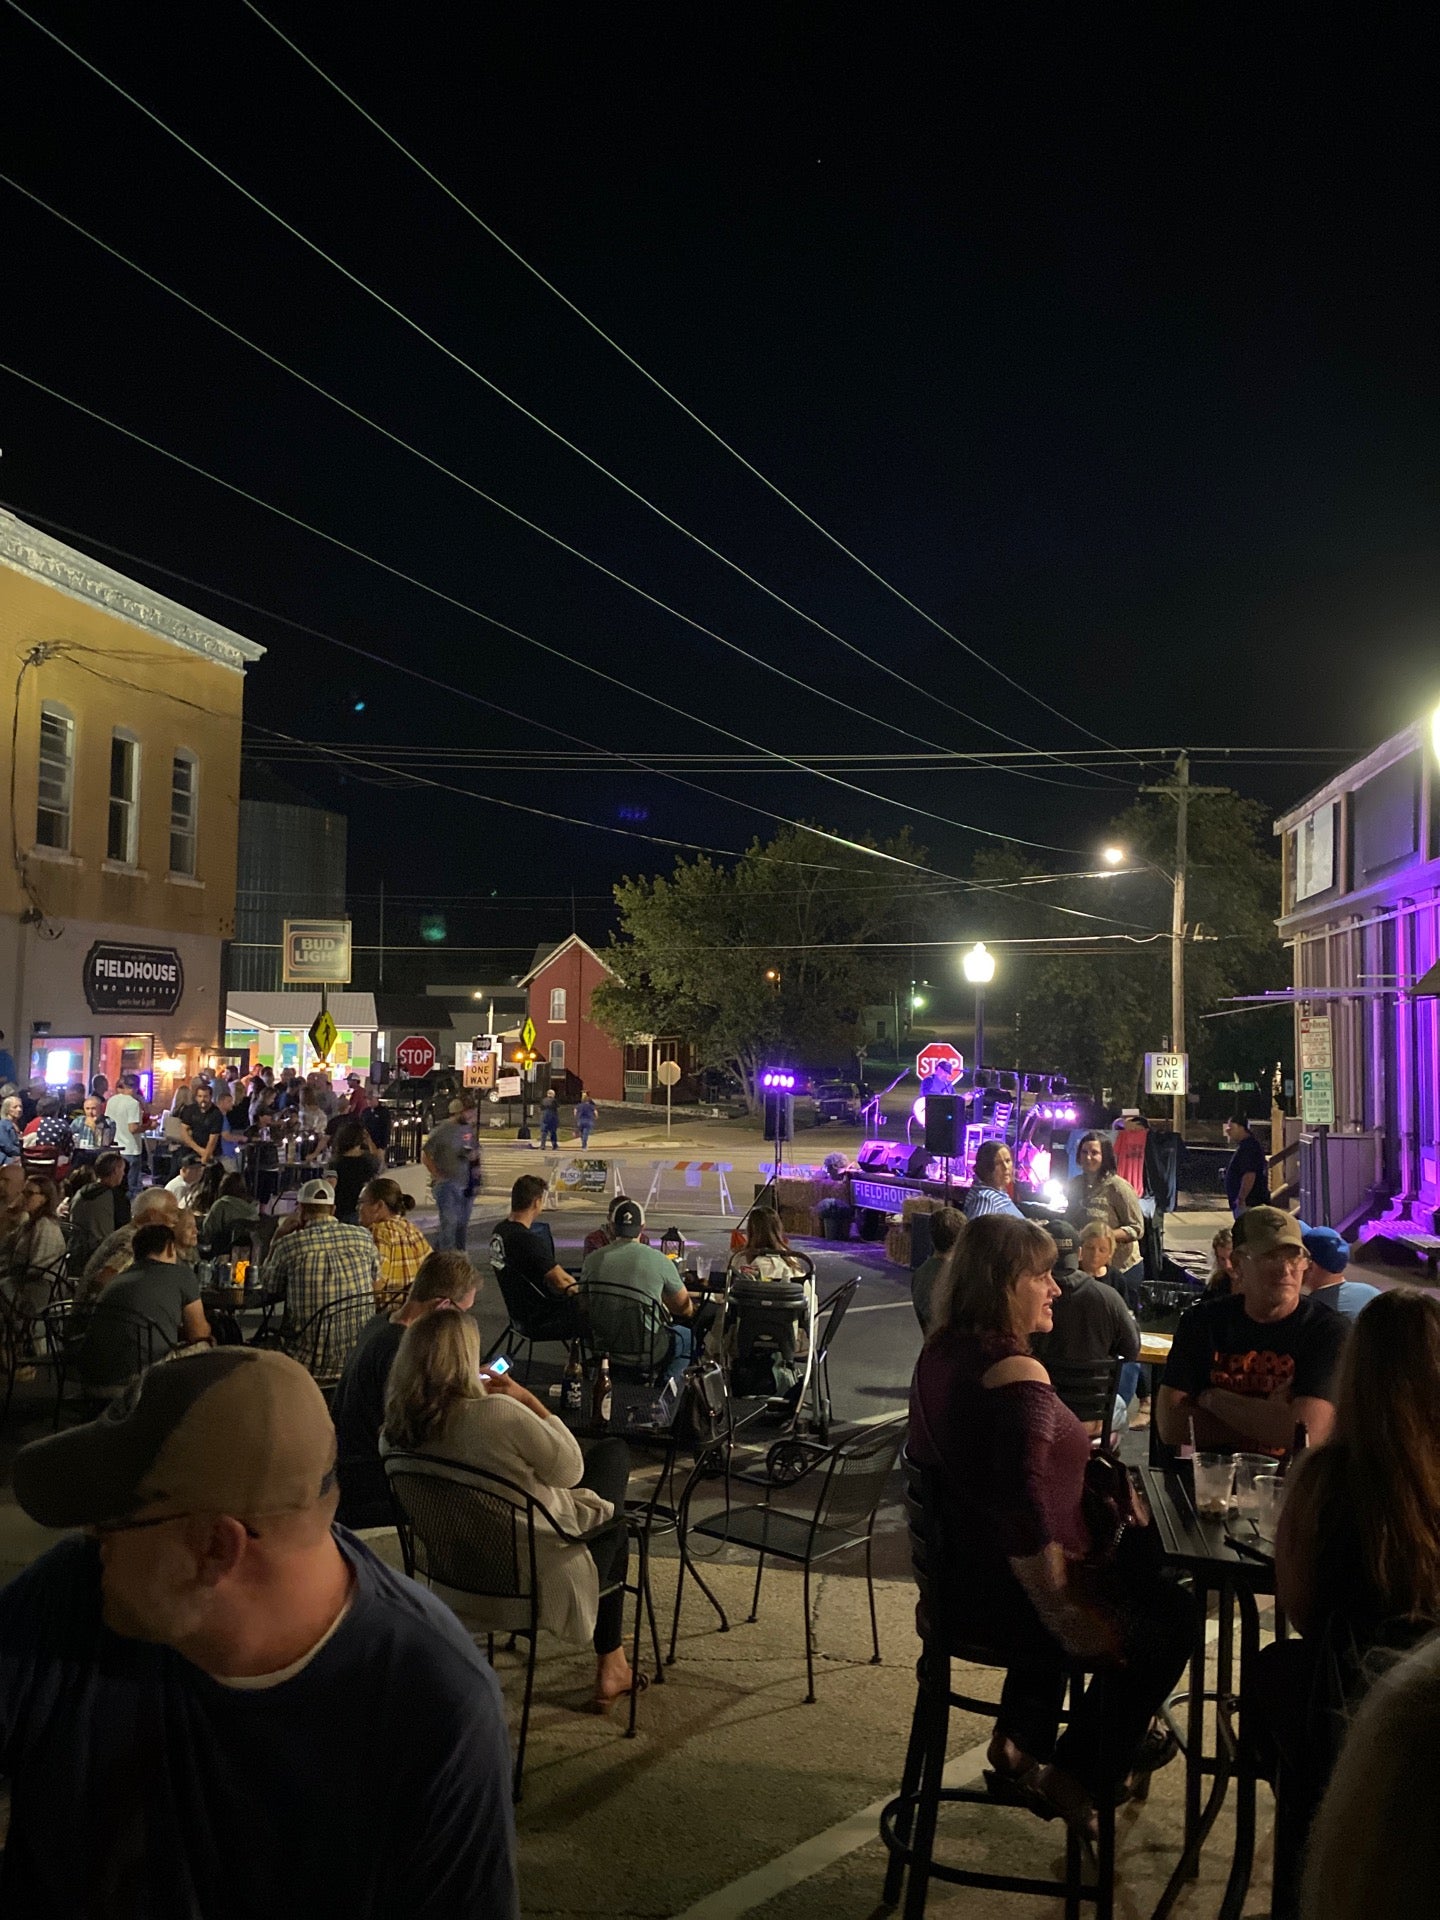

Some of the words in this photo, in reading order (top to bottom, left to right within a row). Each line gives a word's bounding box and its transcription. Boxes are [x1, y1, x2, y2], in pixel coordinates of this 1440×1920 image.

[301, 938, 335, 950] BUD
[95, 959, 176, 981] FIELDHOUSE
[95, 983, 117, 992] TWO
[125, 985, 176, 994] NINETEEN
[400, 1049, 433, 1065] STOP
[472, 1055, 489, 1063] END
[1156, 1056, 1178, 1066] END
[471, 1065, 489, 1073] ONE
[920, 1057, 960, 1074] STP
[1156, 1069, 1179, 1078] ONE
[470, 1076, 489, 1085] WAY
[1304, 1073, 1312, 1088] 2
[1155, 1081, 1179, 1091] WAY
